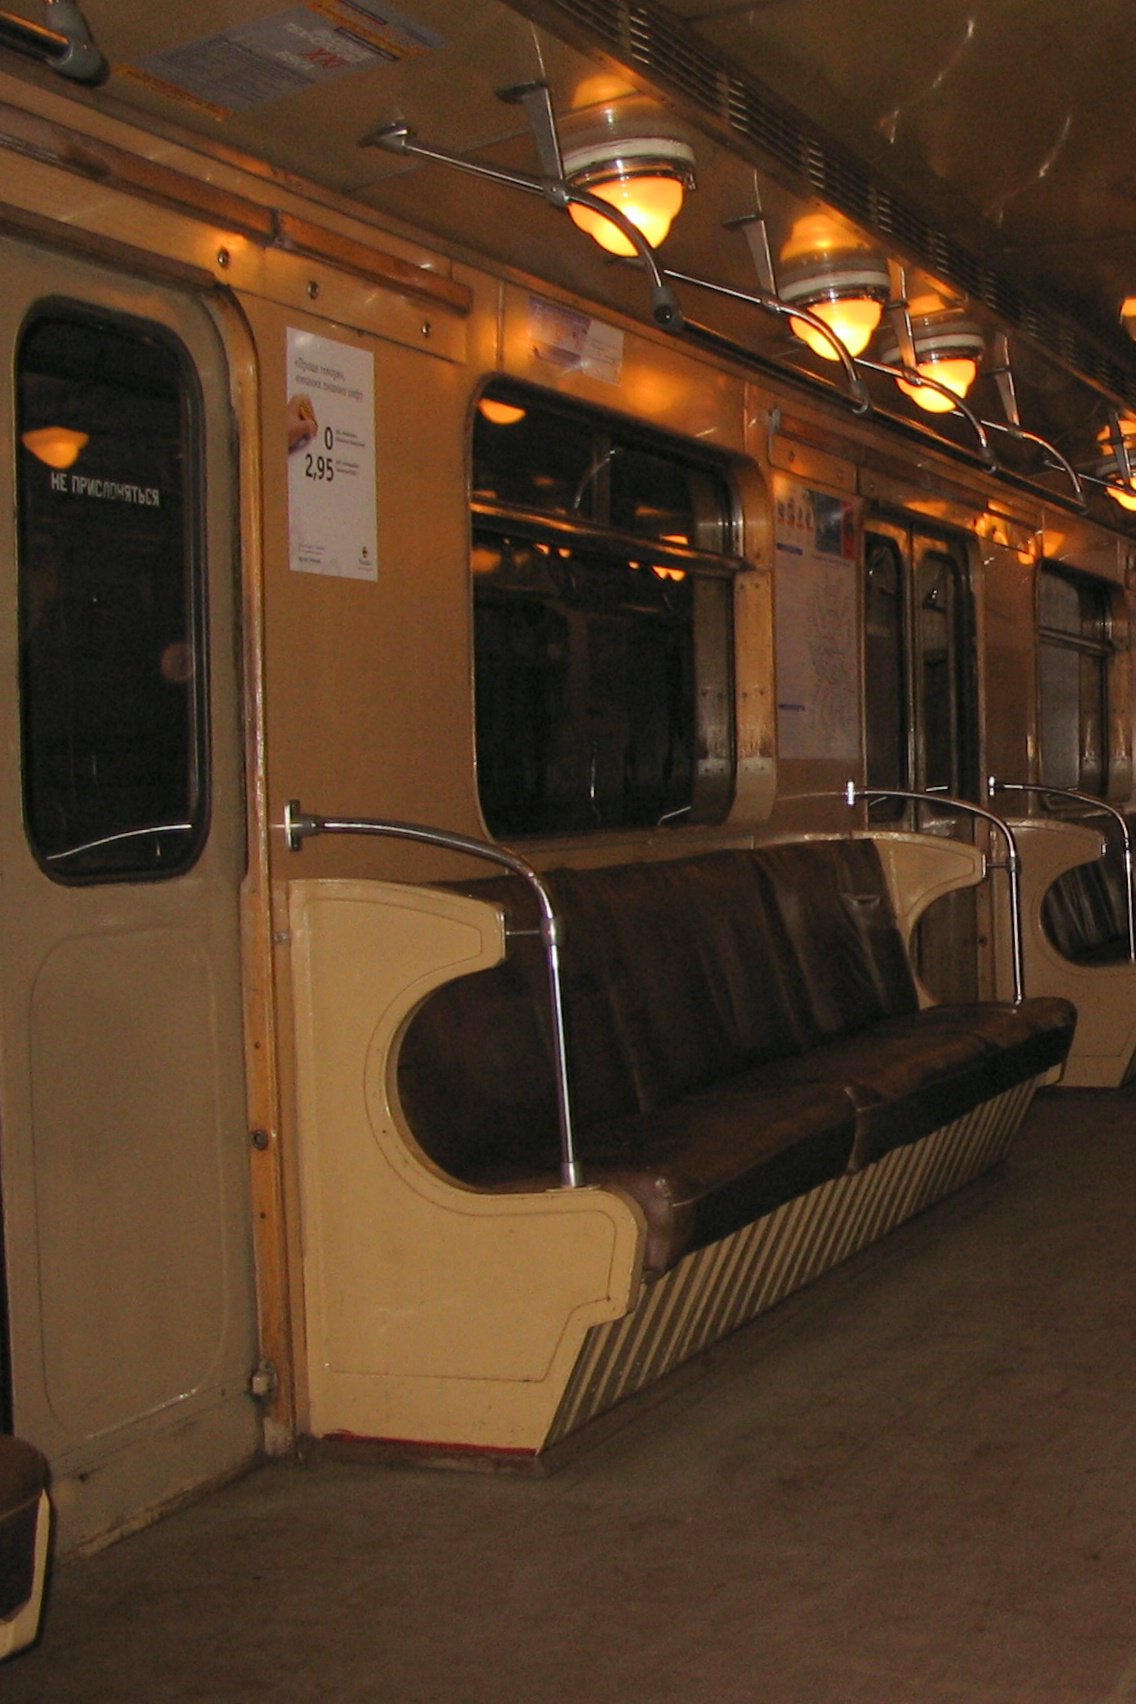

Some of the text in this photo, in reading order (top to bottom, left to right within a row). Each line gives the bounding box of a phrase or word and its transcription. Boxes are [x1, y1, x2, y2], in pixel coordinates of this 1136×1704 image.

[324, 426, 334, 450] 0
[305, 453, 334, 482] 2,95
[51, 471, 67, 492] НЕ
